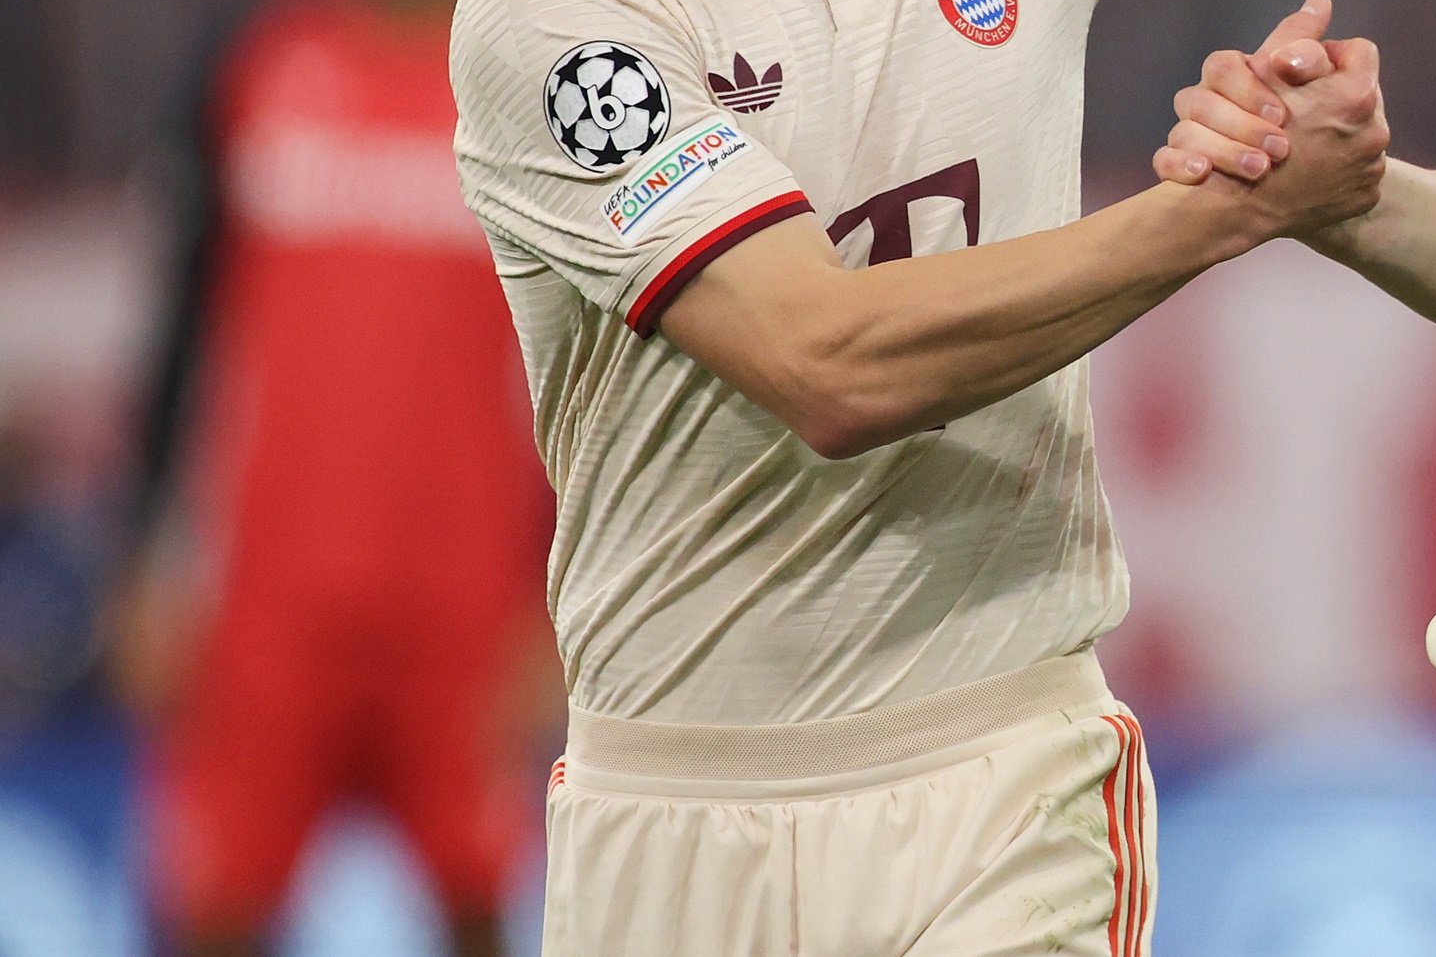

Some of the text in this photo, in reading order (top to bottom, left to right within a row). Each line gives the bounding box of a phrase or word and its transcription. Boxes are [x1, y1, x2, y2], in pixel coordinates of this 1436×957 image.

[586, 84, 627, 131] 6
[719, 140, 748, 160] children
[610, 126, 738, 230] FOUNDATION
[603, 184, 631, 216] UEFA
